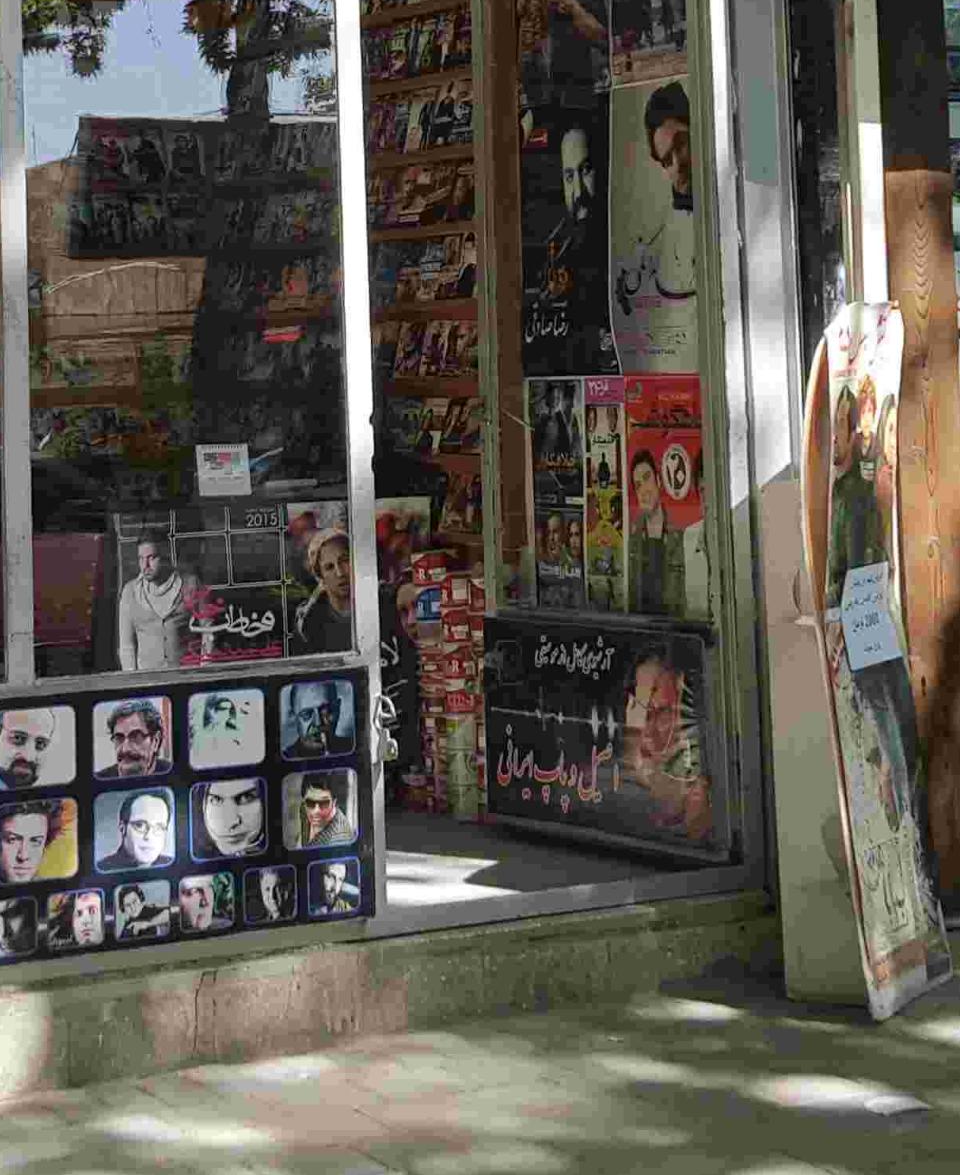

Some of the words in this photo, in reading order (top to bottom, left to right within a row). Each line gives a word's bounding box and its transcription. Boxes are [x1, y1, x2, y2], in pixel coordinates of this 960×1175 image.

[246, 512, 278, 527] 2015
[497, 724, 535, 801] ایرانی
[534, 749, 571, 814] پاپ
